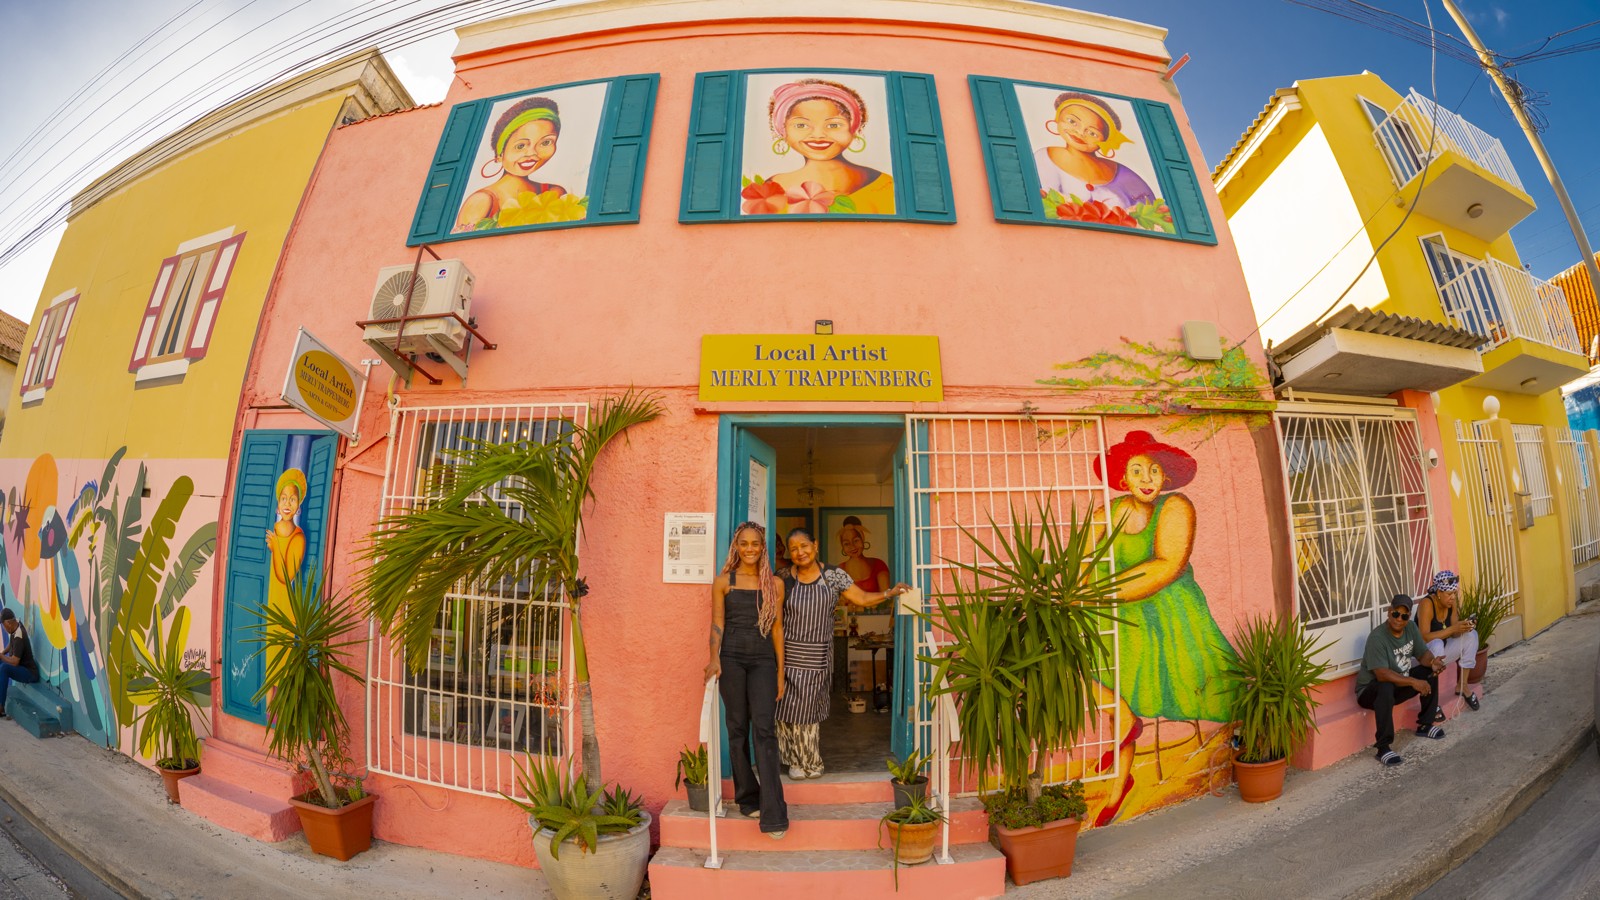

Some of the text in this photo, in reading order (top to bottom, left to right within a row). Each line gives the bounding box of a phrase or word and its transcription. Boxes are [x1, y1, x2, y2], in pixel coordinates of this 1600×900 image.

[754, 344, 888, 362] Local Artist
[300, 369, 350, 409] MERLY TRAPPENBERG
[303, 355, 353, 399] Local Artist
[710, 369, 932, 388] MERLY TRAPPENBERG
